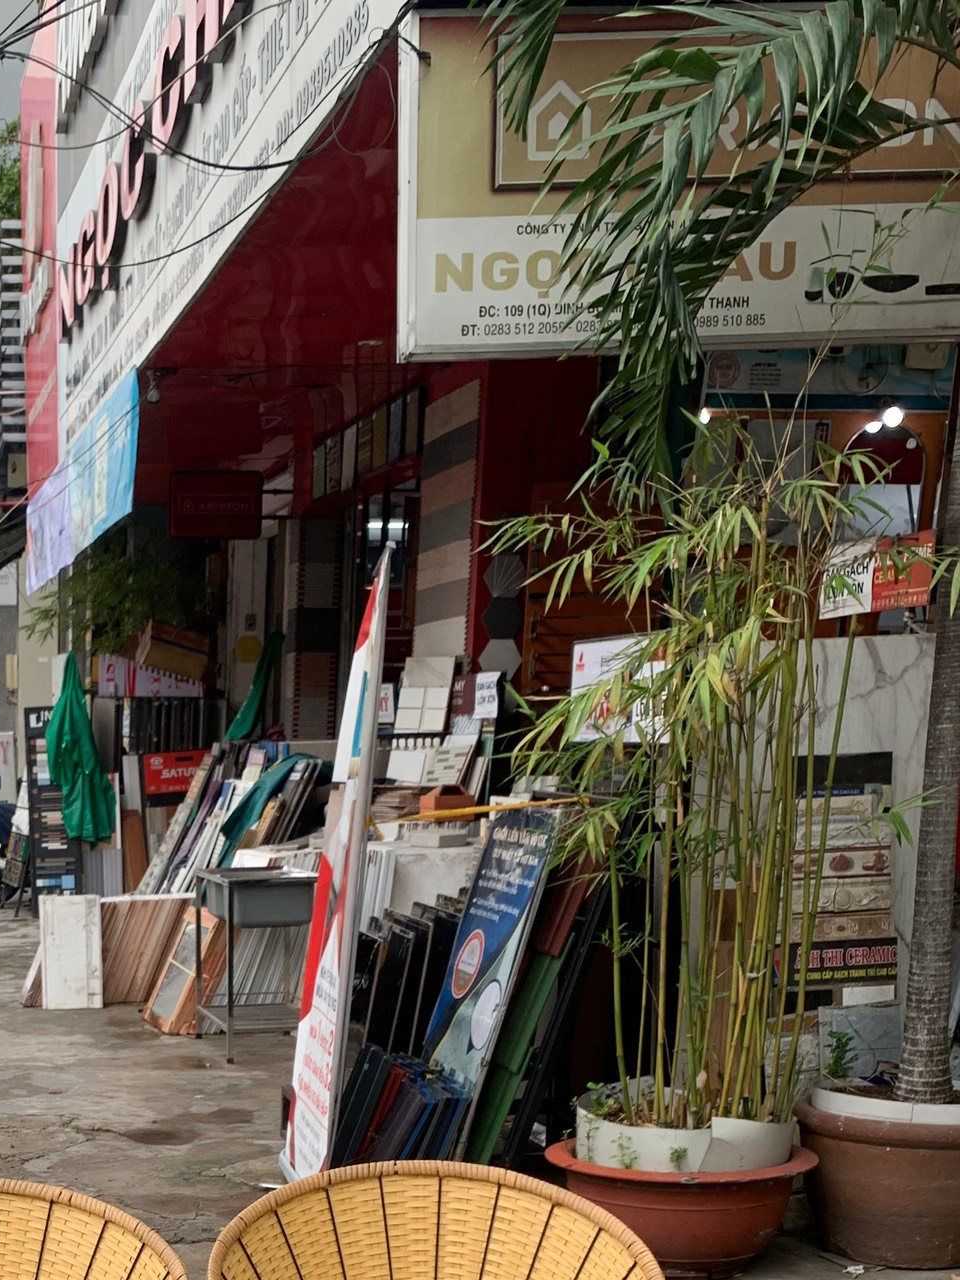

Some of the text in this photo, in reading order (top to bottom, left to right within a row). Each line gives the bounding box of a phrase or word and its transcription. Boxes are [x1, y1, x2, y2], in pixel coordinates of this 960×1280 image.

[58, 100, 145, 327] NGỌC
[152, 0, 235, 155] CH
[516, 222, 549, 236] CÔNG
[552, 224, 566, 234] TY
[479, 306, 500, 318] ĐC:
[504, 305, 524, 318] 109
[527, 304, 551, 320] (1Q)
[709, 296, 750, 312] THẠNH
[461, 324, 480, 336] ĐT:
[483, 322, 511, 336] 0283
[514, 322, 534, 335] 512
[722, 315, 743, 327] 510
[745, 313, 766, 326] 885
[794, 945, 898, 969] ÁH THI CERAMIC
[877, 967, 887, 977] CAO
